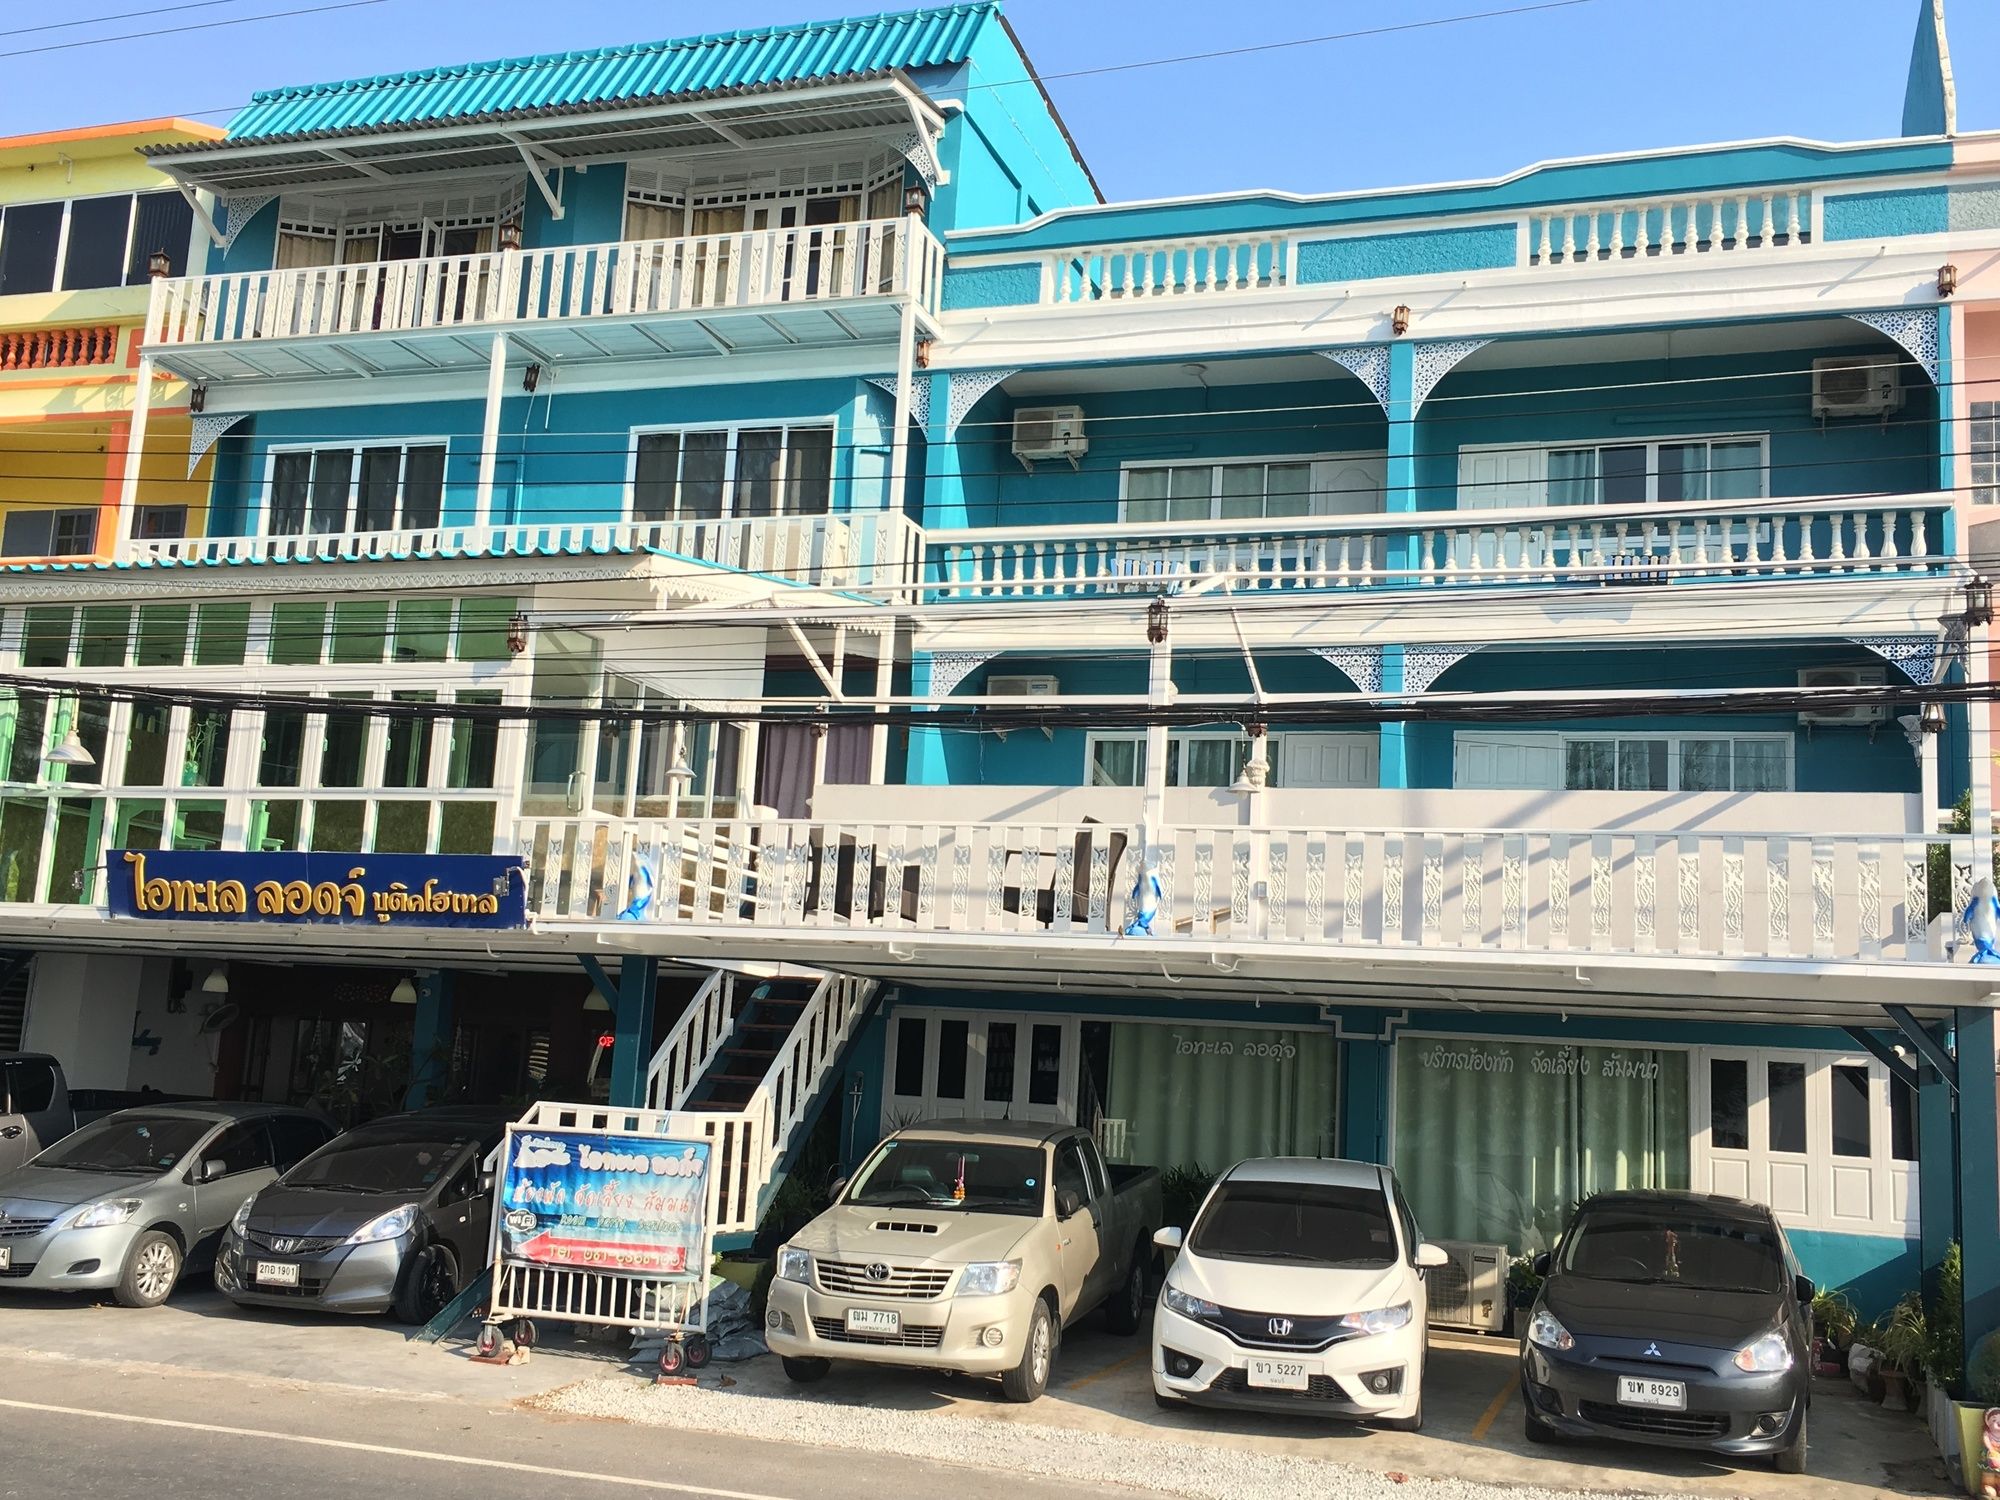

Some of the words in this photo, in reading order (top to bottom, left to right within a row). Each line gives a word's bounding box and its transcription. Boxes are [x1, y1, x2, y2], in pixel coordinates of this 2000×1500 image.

[124, 851, 246, 914] ไอทะเล
[254, 867, 366, 917] ลอดจ์
[278, 1266, 295, 1276] 1901
[873, 1312, 897, 1324] 7718
[1277, 1363, 1303, 1376] 5227
[1651, 1384, 1679, 1397] 8929
